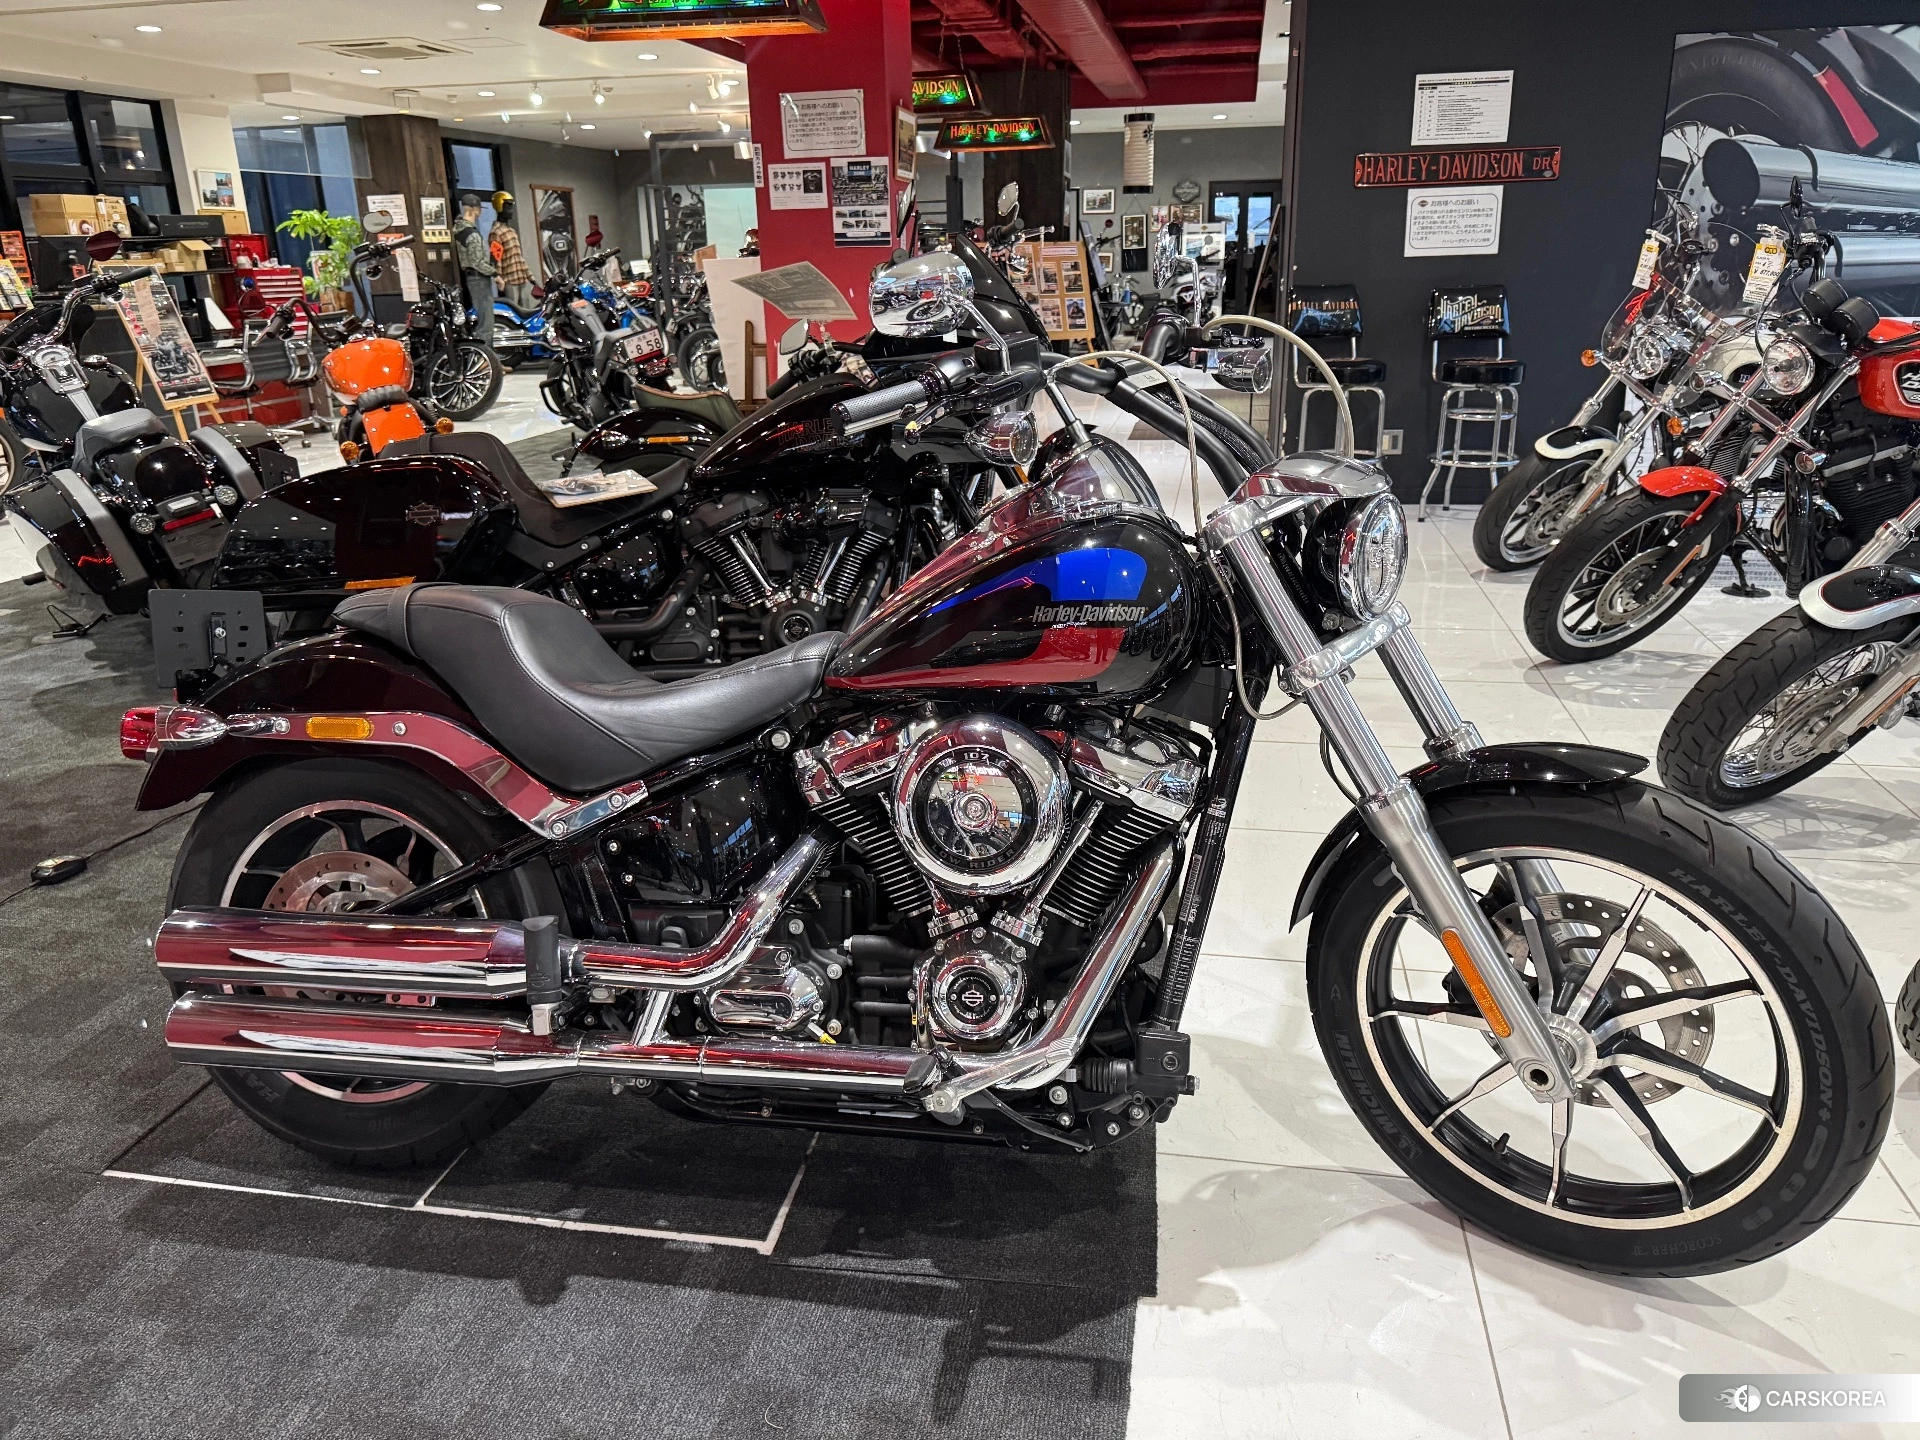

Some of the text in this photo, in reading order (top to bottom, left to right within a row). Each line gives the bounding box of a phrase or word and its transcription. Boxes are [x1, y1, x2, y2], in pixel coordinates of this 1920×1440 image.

[1362, 151, 1551, 183] HARLEY-DAVIDSON DR
[1430, 199, 1479, 207] お客様へのお願い
[1032, 602, 1147, 623] Harley-Davidson
[963, 752, 990, 761] 107
[931, 844, 1016, 869] LOW RIDER
[1334, 1031, 1400, 1136] MICHELIN
[1651, 1235, 1722, 1256] SCORCHER
